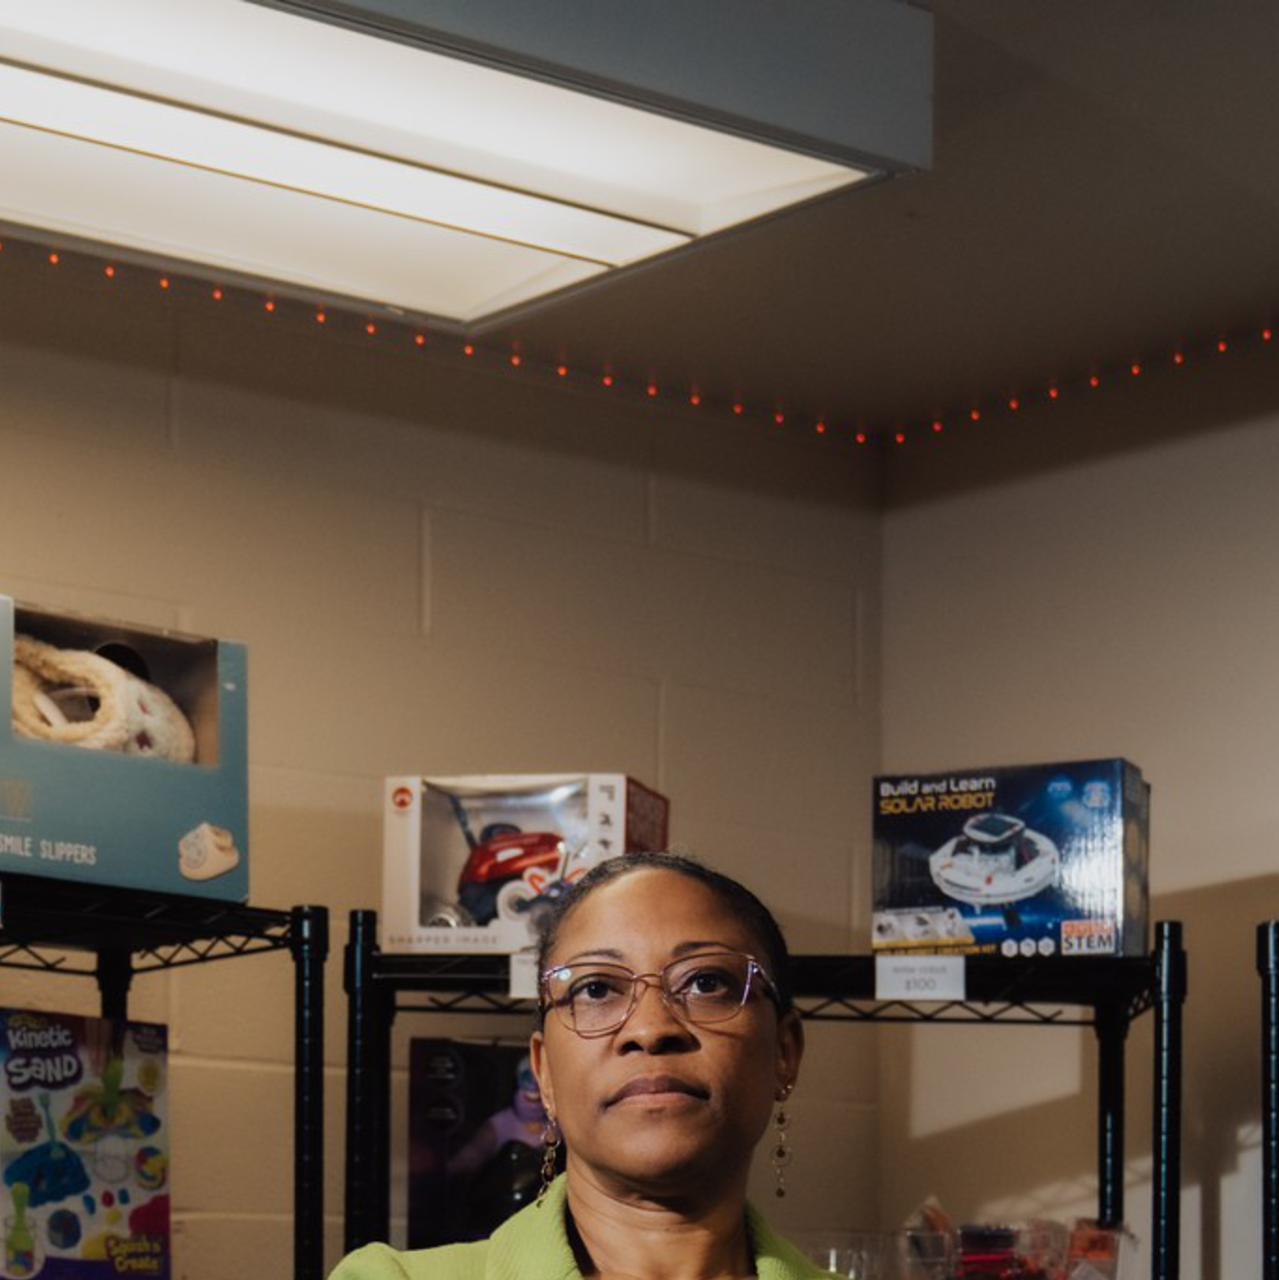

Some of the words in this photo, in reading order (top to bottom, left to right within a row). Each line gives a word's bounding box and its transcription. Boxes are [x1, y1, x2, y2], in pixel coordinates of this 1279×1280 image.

[879, 781, 919, 798] Build
[922, 780, 947, 794] and
[950, 777, 996, 792] Learn
[879, 795, 937, 815] SOLAR
[938, 791, 996, 810] ROBOT
[39, 839, 98, 865] SLIPPERS
[456, 935, 498, 945] IMAGE
[1064, 935, 1113, 951] STEM
[7, 1024, 73, 1050] Kinetic
